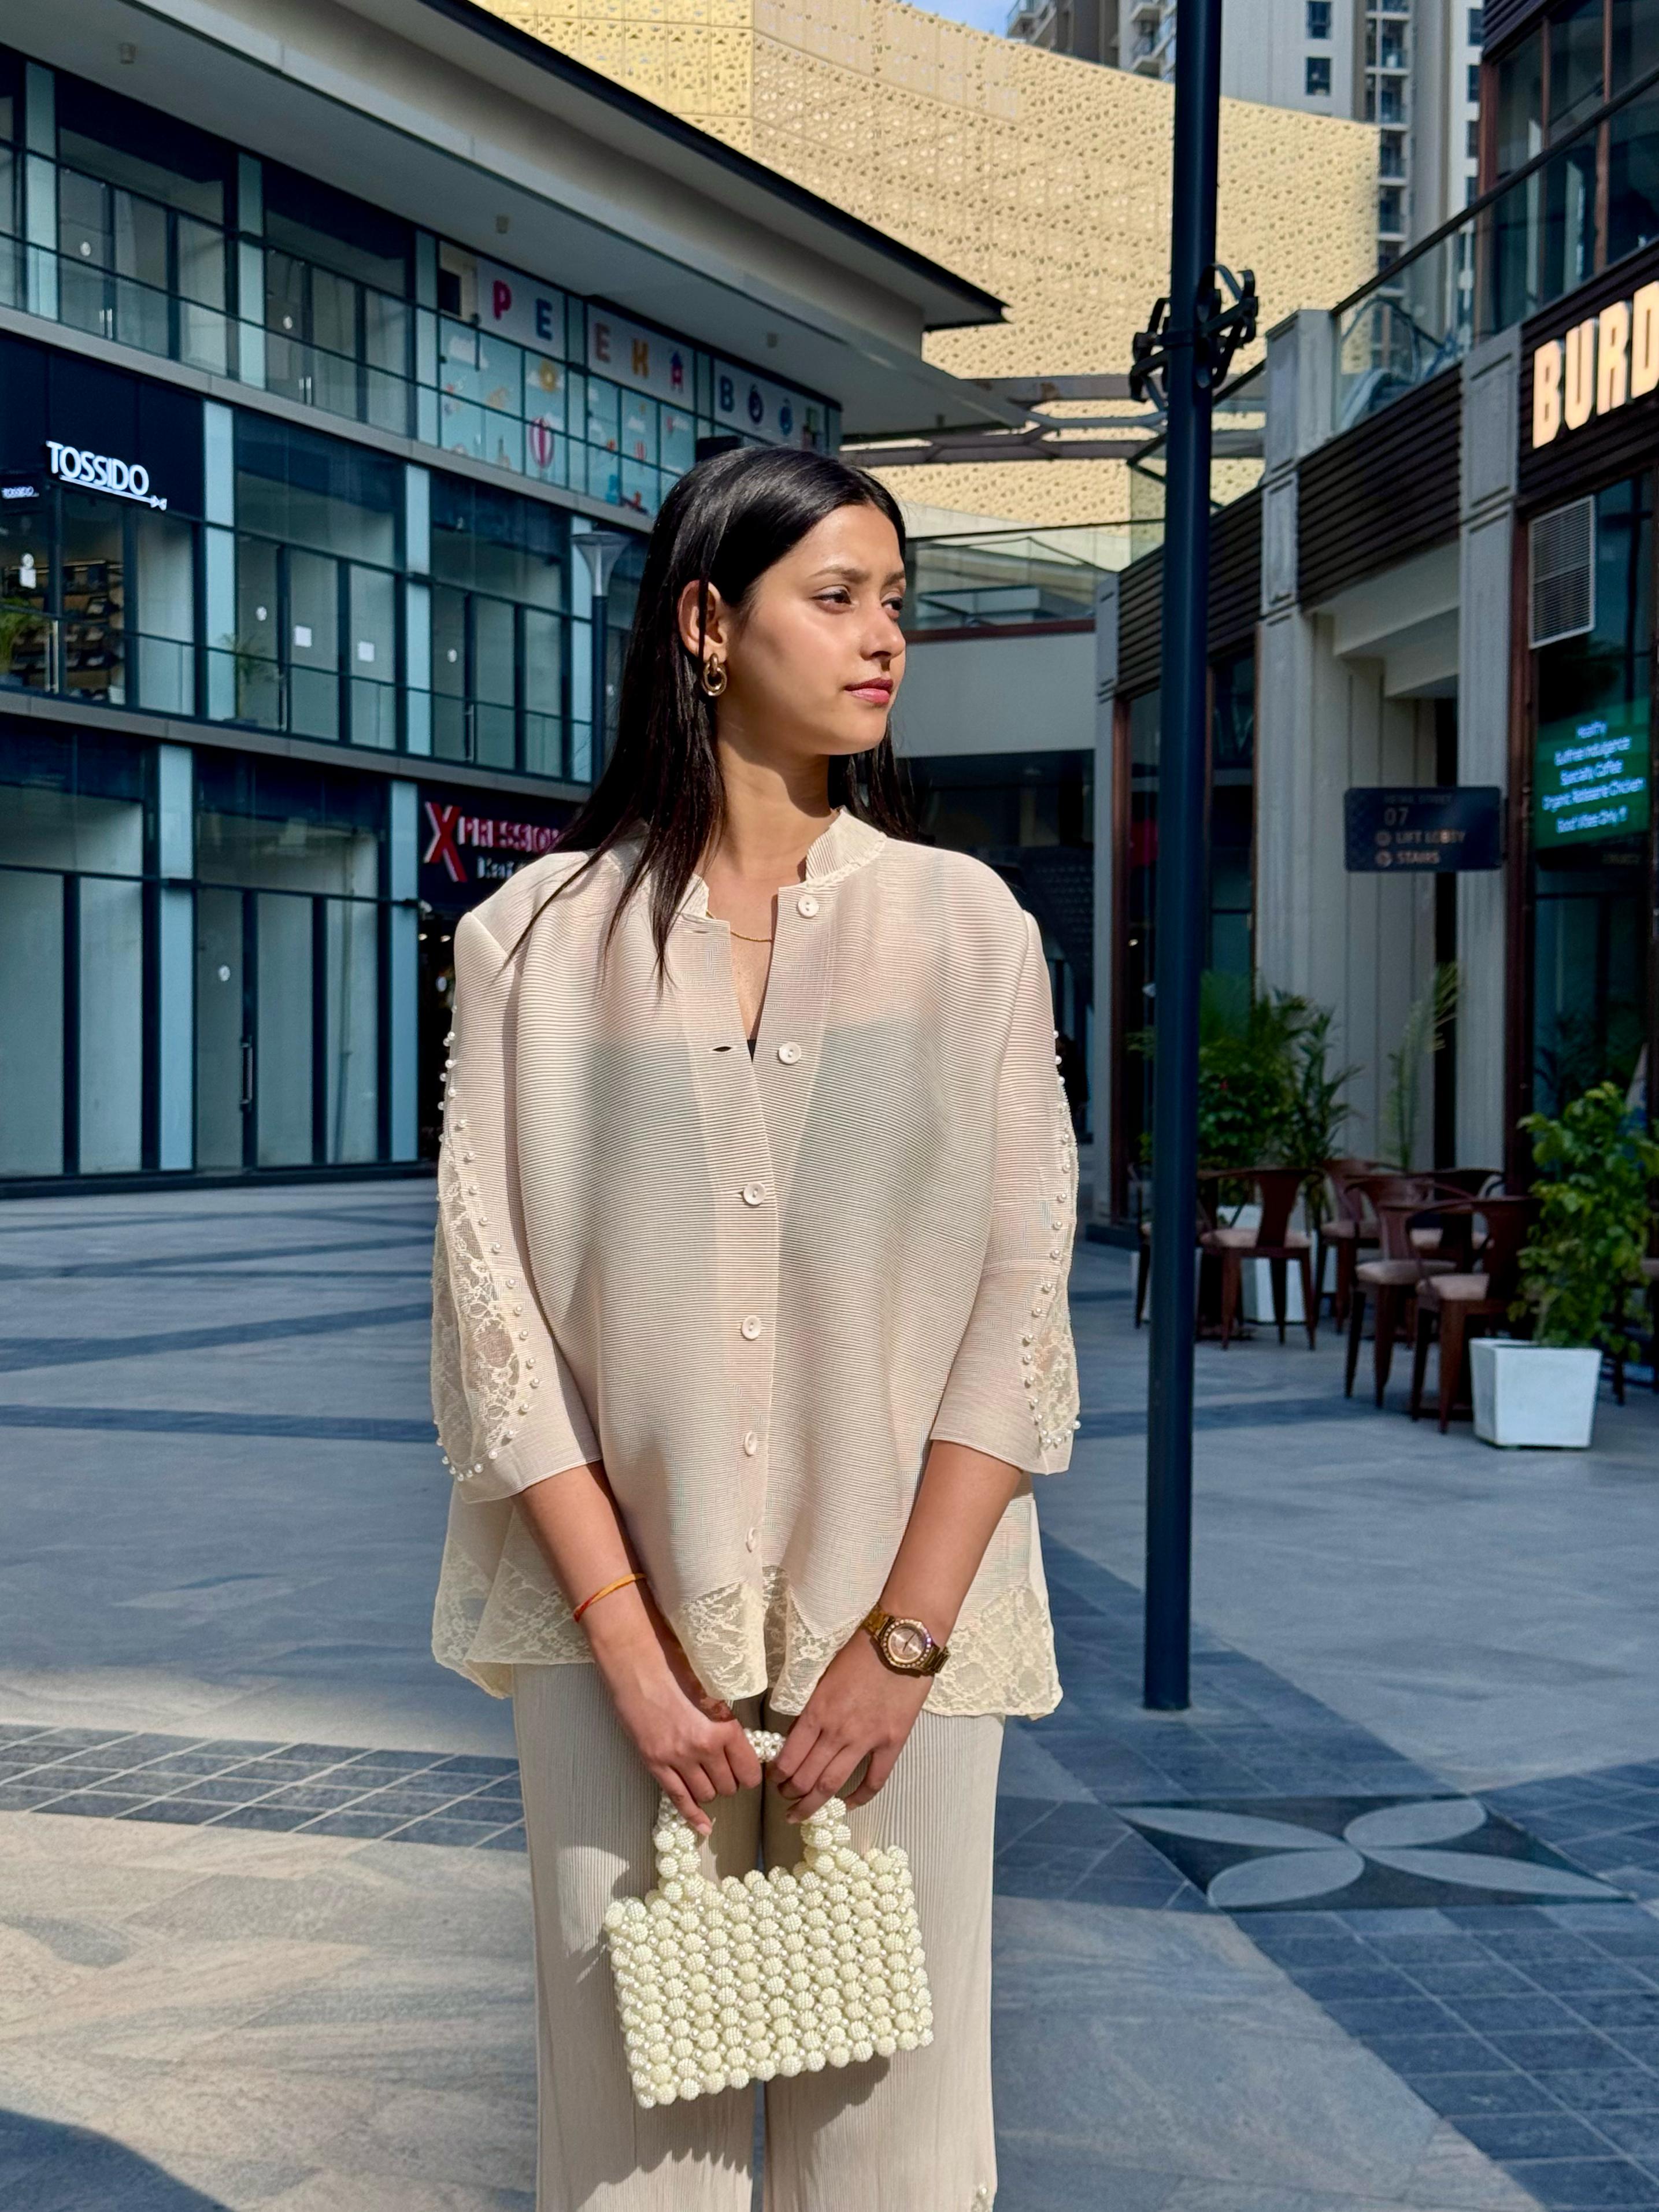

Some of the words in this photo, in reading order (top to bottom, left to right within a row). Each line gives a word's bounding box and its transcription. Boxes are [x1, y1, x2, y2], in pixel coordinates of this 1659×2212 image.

[1533, 280, 1659, 450] BURD
[46, 440, 149, 496] TOSSIDO
[1383, 806, 1409, 827] 07
